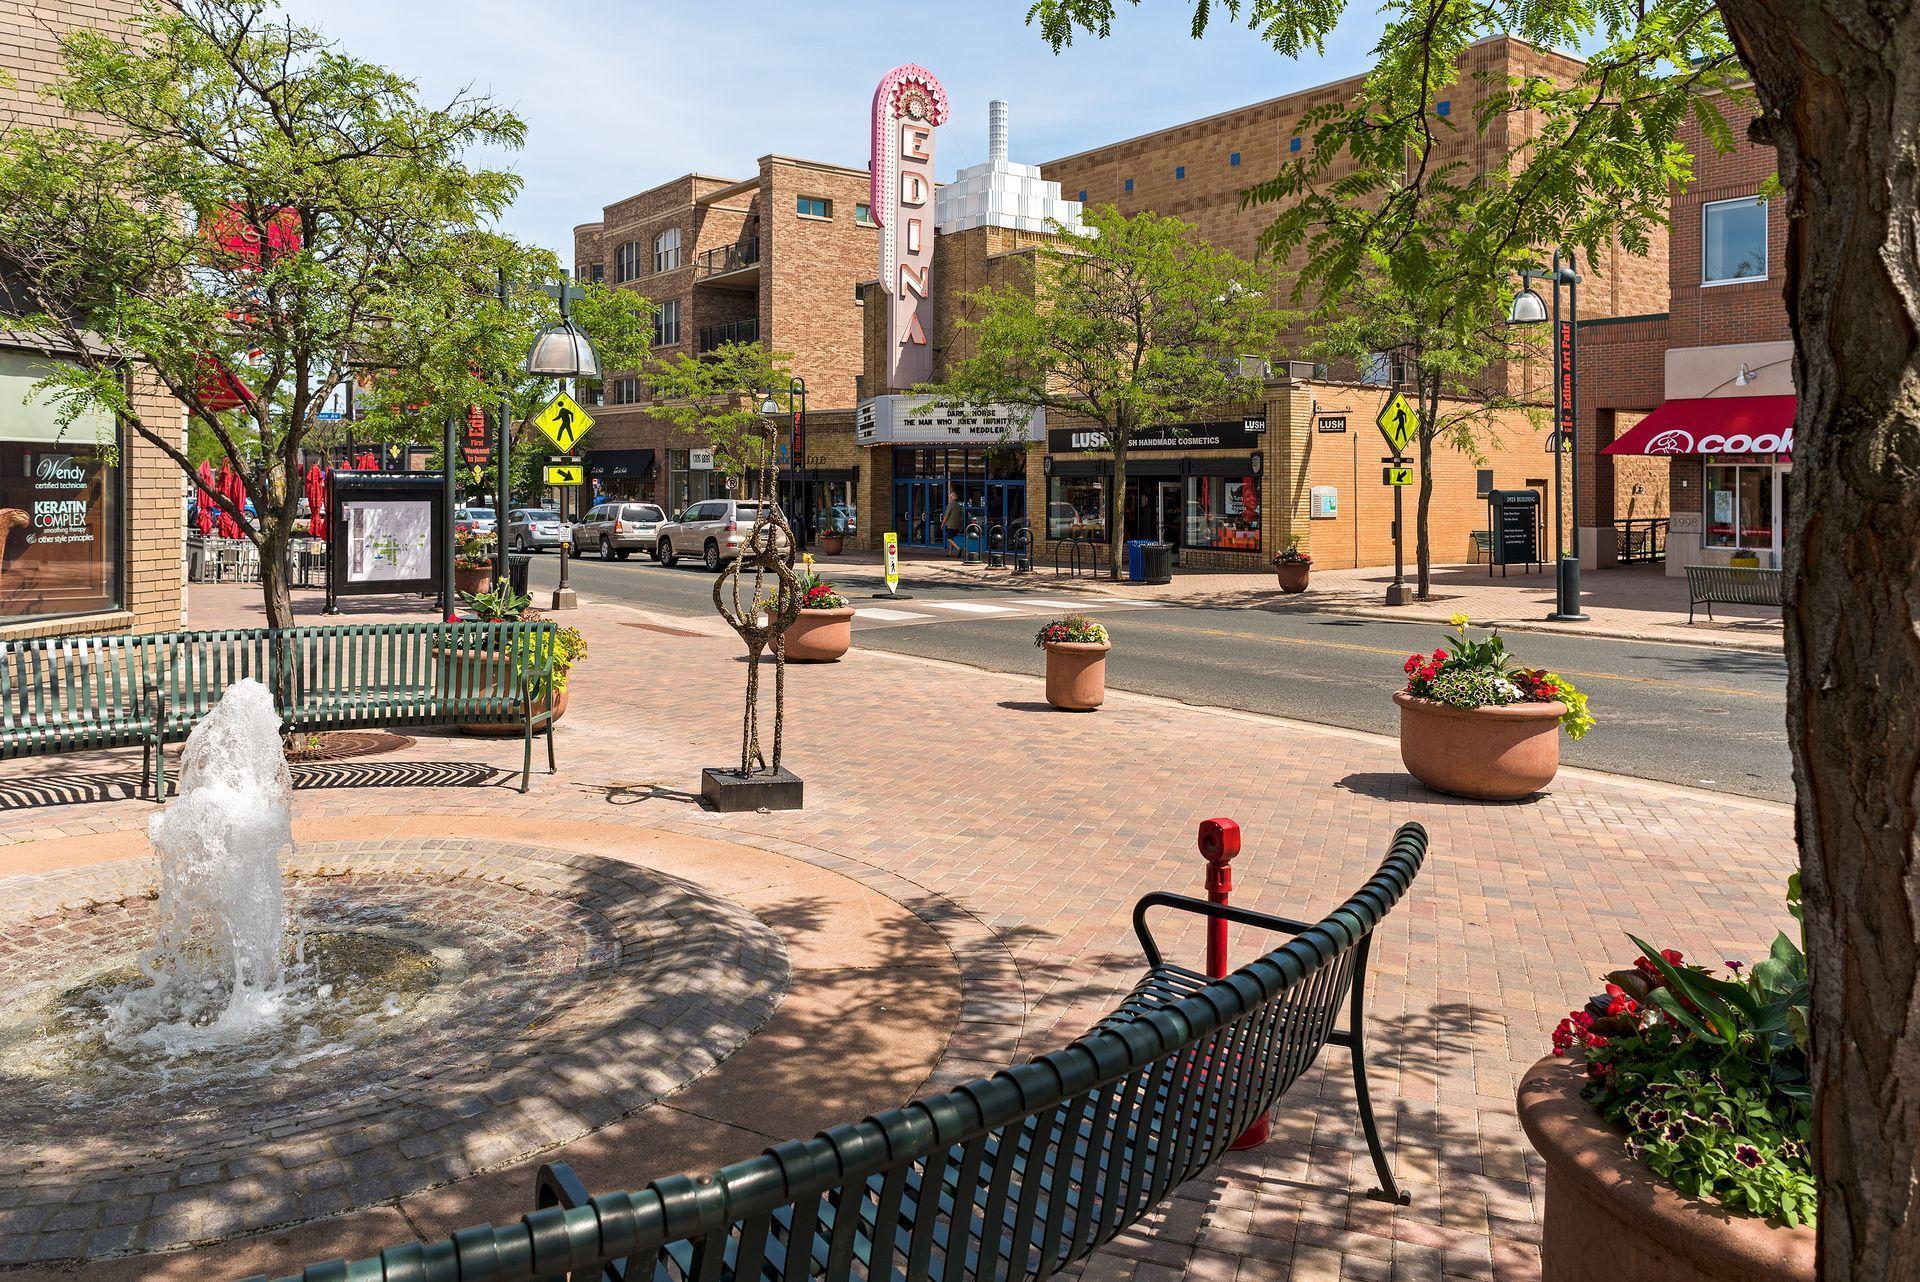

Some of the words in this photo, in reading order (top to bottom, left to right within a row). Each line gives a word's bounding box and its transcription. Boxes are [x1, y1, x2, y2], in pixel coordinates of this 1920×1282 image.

[901, 124, 930, 345] EDINA
[1561, 323, 1571, 349] Fair
[1562, 351, 1571, 371] Art
[1562, 374, 1572, 410] Edina
[1244, 420, 1265, 429] LUSH
[1319, 420, 1344, 429] LUSH
[1138, 438, 1177, 447] HANDMADE
[1178, 436, 1220, 446] COSMETICS
[36, 457, 85, 481] Wendy
[34, 501, 87, 514] KERATIN
[34, 513, 86, 527] COMPLEX
[1673, 518, 1699, 527] 1998
[56, 535, 68, 543] style
[68, 534, 94, 543] principles
